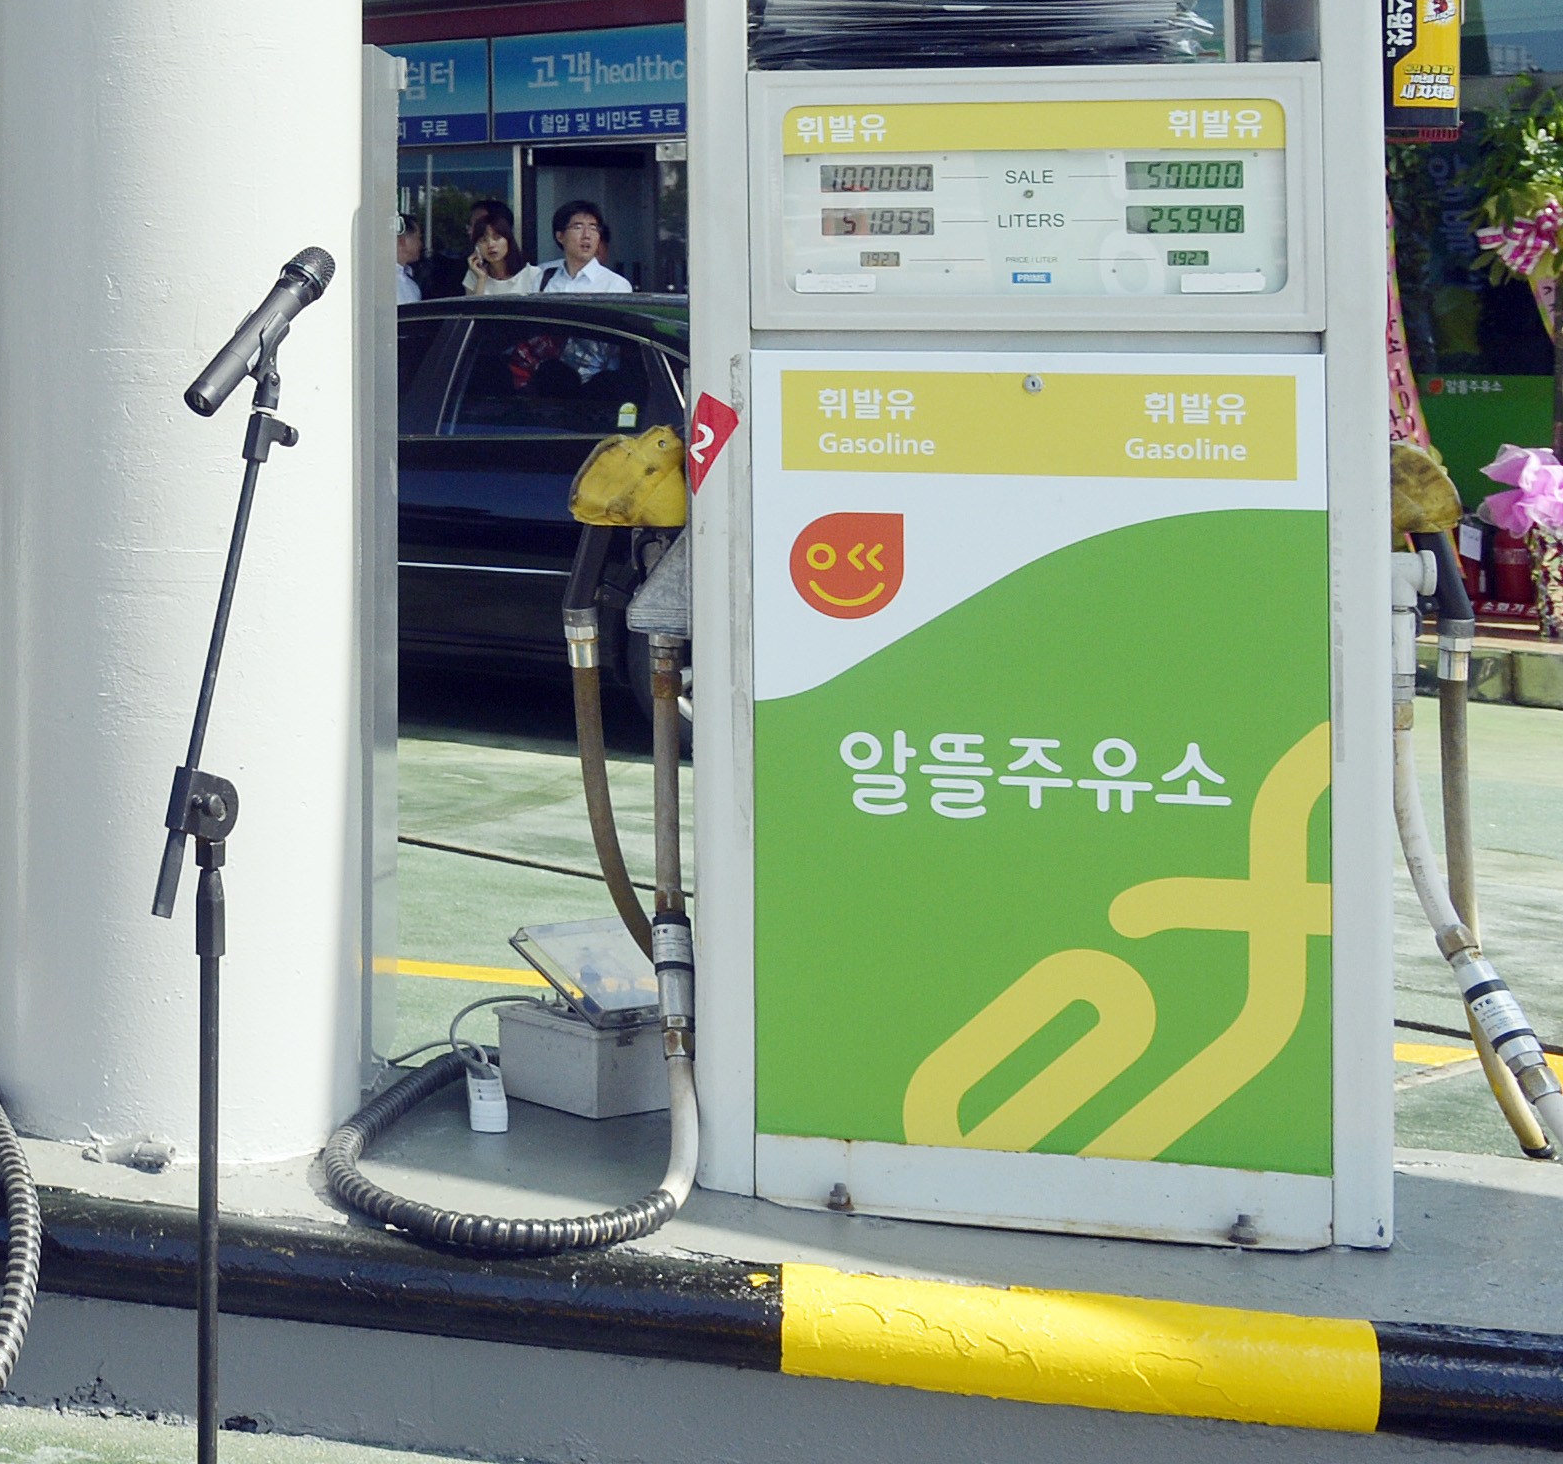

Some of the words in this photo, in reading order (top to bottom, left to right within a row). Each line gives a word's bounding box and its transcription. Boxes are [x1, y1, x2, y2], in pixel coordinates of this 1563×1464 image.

[528, 51, 593, 95] 고객
[595, 109, 644, 132] 비만도
[648, 108, 682, 130] 무료
[796, 114, 887, 143] 휘발유
[1167, 109, 1263, 139] 휘발유
[1005, 169, 1054, 184] SALE
[1147, 162, 1242, 188] 50000
[998, 213, 1065, 229] LITERS
[817, 387, 917, 422] 휘발유
[1143, 391, 1249, 426] 휘발유
[690, 423, 716, 462] 2
[817, 432, 936, 457] Gasoline
[1124, 437, 1249, 463] Gasoline
[839, 730, 1233, 820] 알뜰주유소
